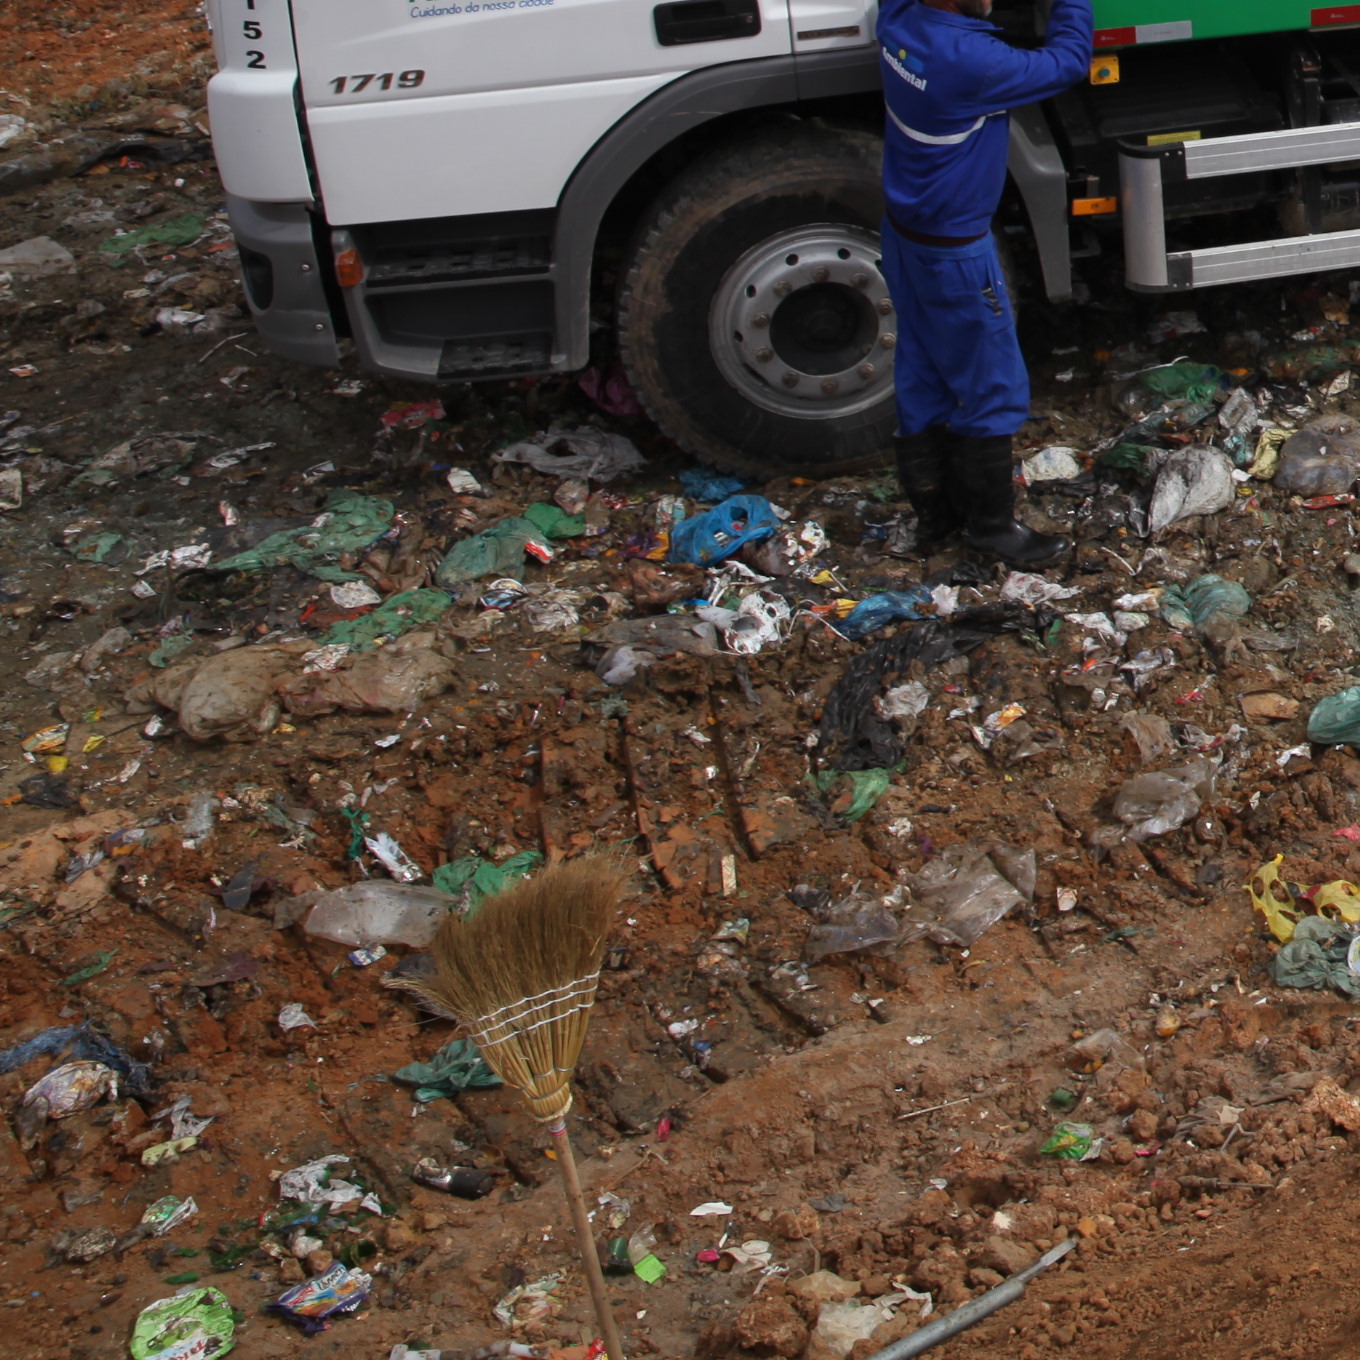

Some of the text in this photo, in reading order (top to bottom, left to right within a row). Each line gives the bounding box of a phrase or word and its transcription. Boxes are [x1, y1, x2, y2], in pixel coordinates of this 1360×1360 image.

[410, 3, 461, 19] Cuidando
[465, 2, 480, 13] da
[482, 1, 515, 11] nossa
[328, 69, 426, 95] 1719
